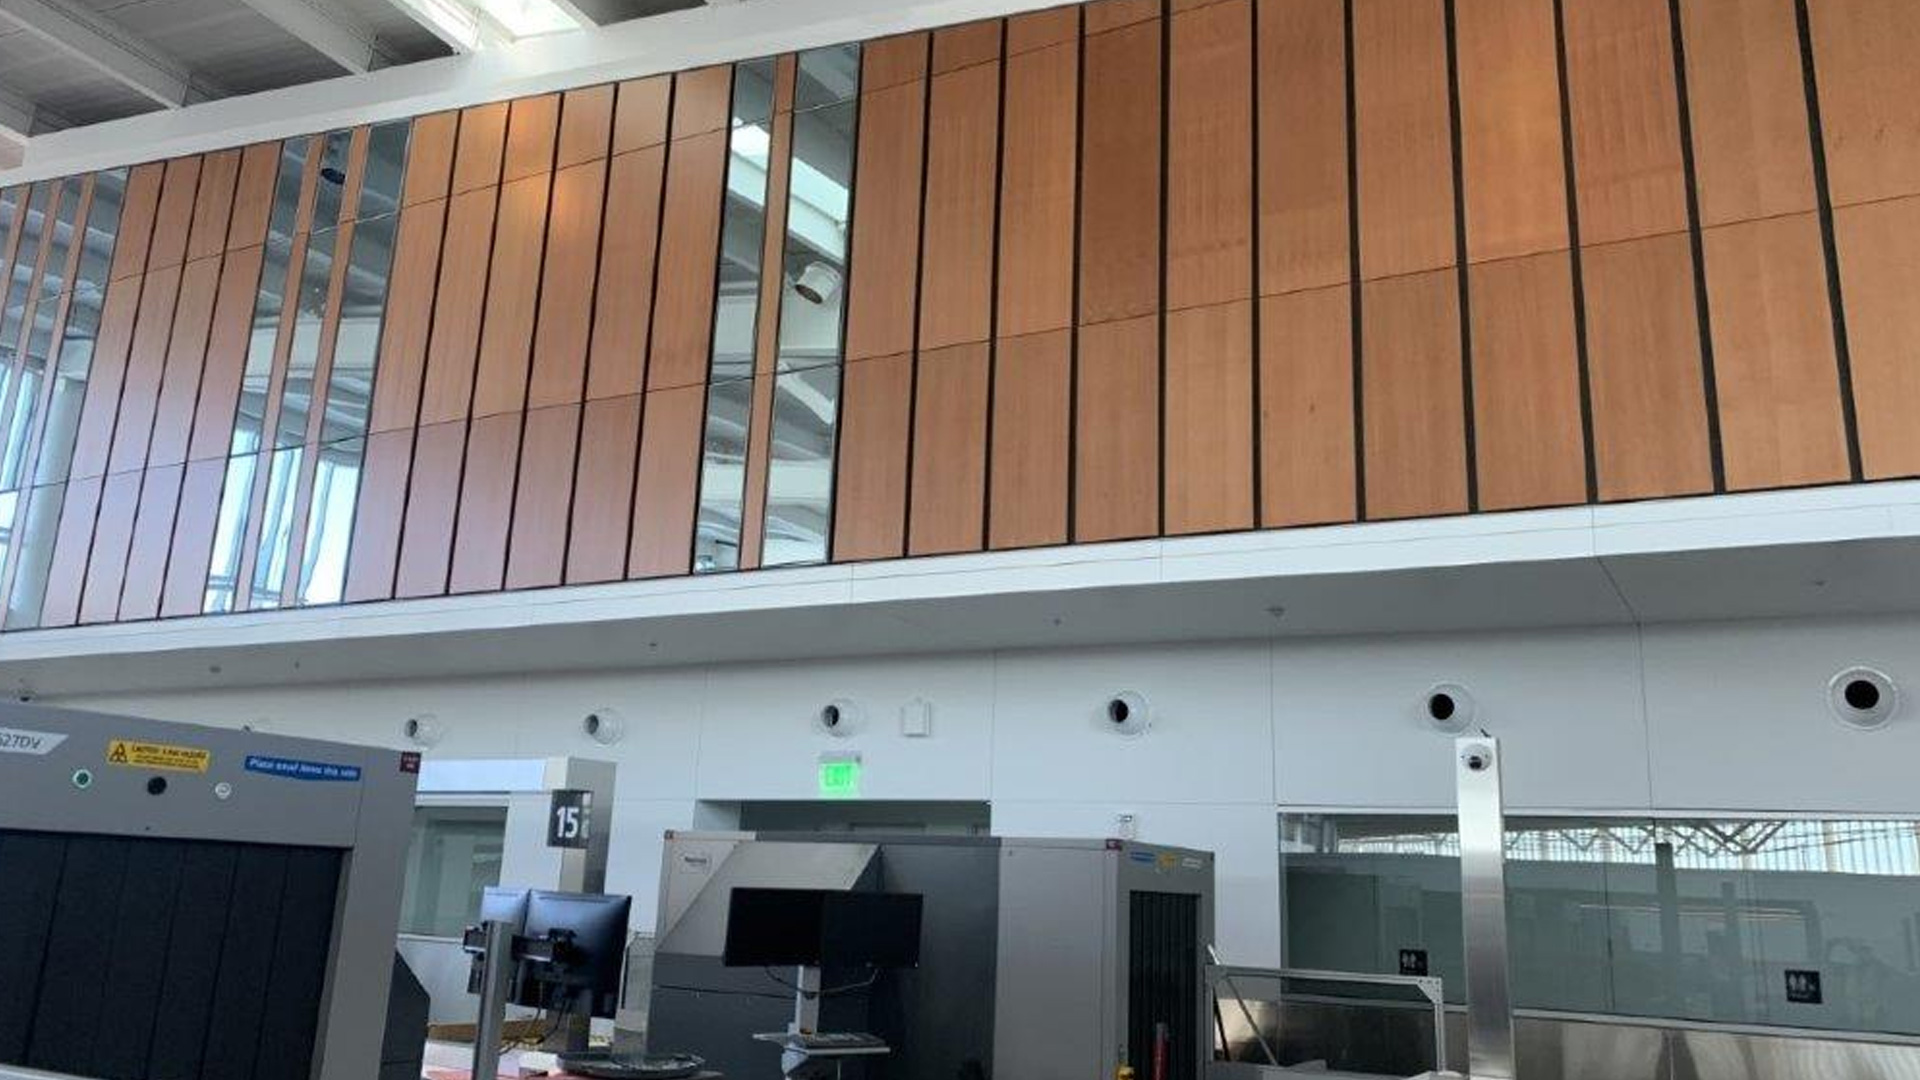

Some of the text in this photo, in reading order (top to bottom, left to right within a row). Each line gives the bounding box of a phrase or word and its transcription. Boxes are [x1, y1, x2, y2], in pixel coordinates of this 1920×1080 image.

[0, 732, 41, 749] 27DV
[825, 764, 853, 787] EXIT
[557, 806, 579, 838] 15
